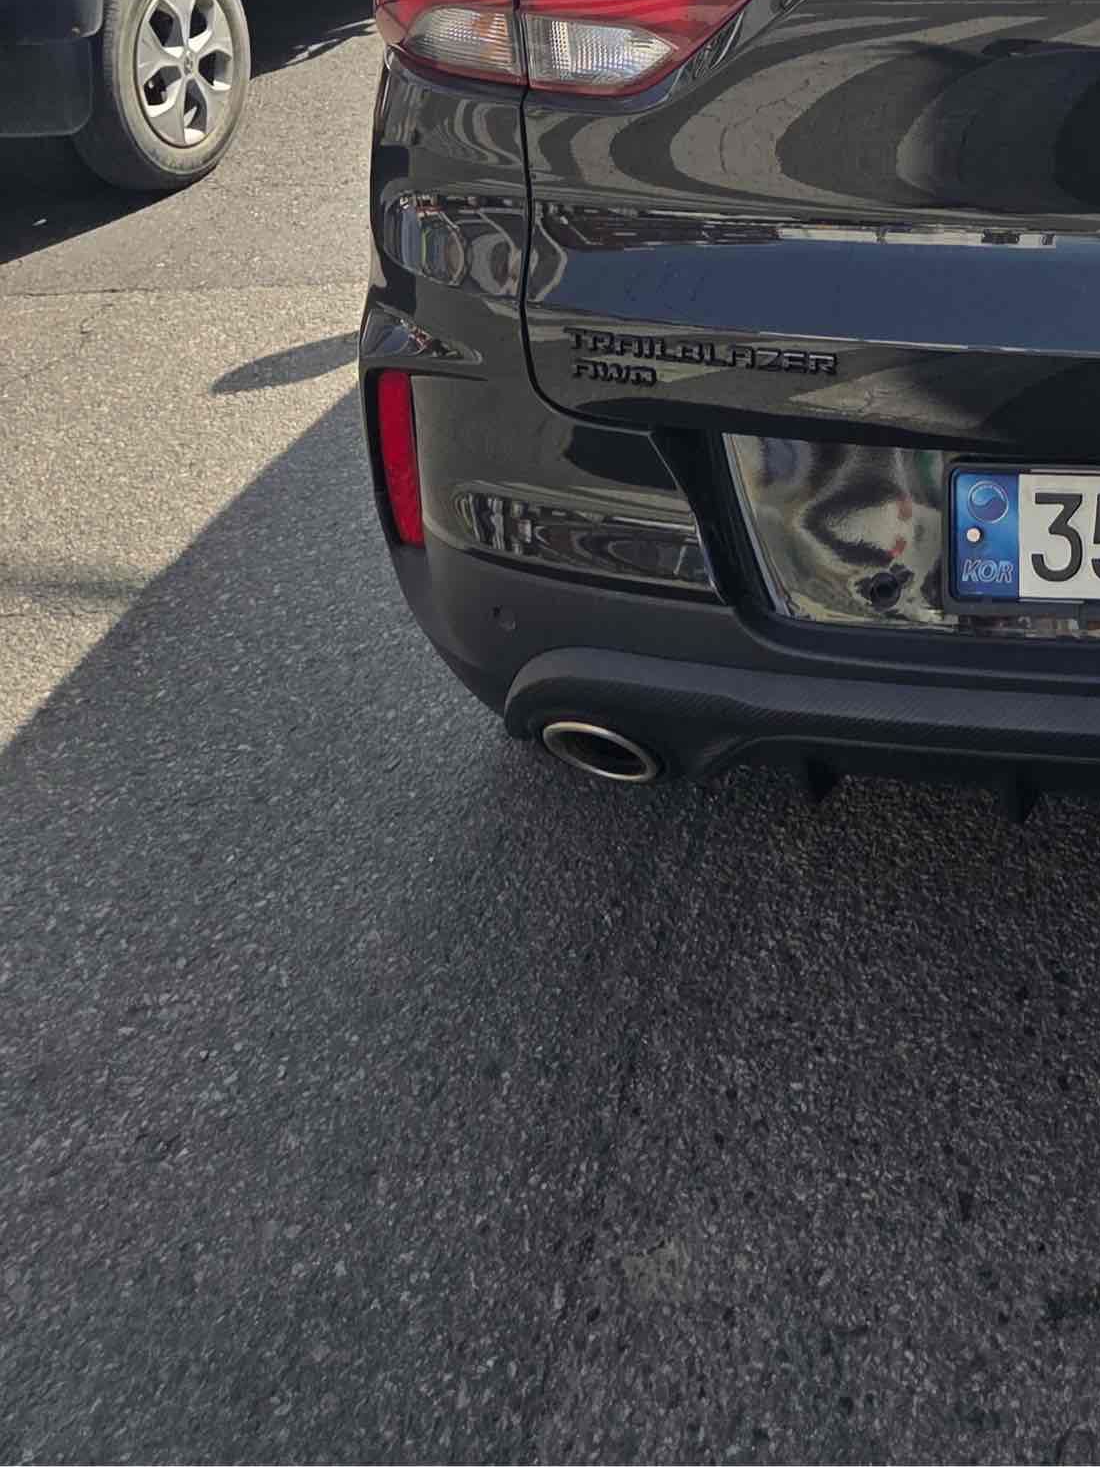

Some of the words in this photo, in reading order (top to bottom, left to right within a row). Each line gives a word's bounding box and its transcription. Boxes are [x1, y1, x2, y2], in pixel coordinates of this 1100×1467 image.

[563, 327, 839, 376] TRAILBLAZER
[571, 357, 658, 387] AWD
[961, 558, 1015, 584] KOR
